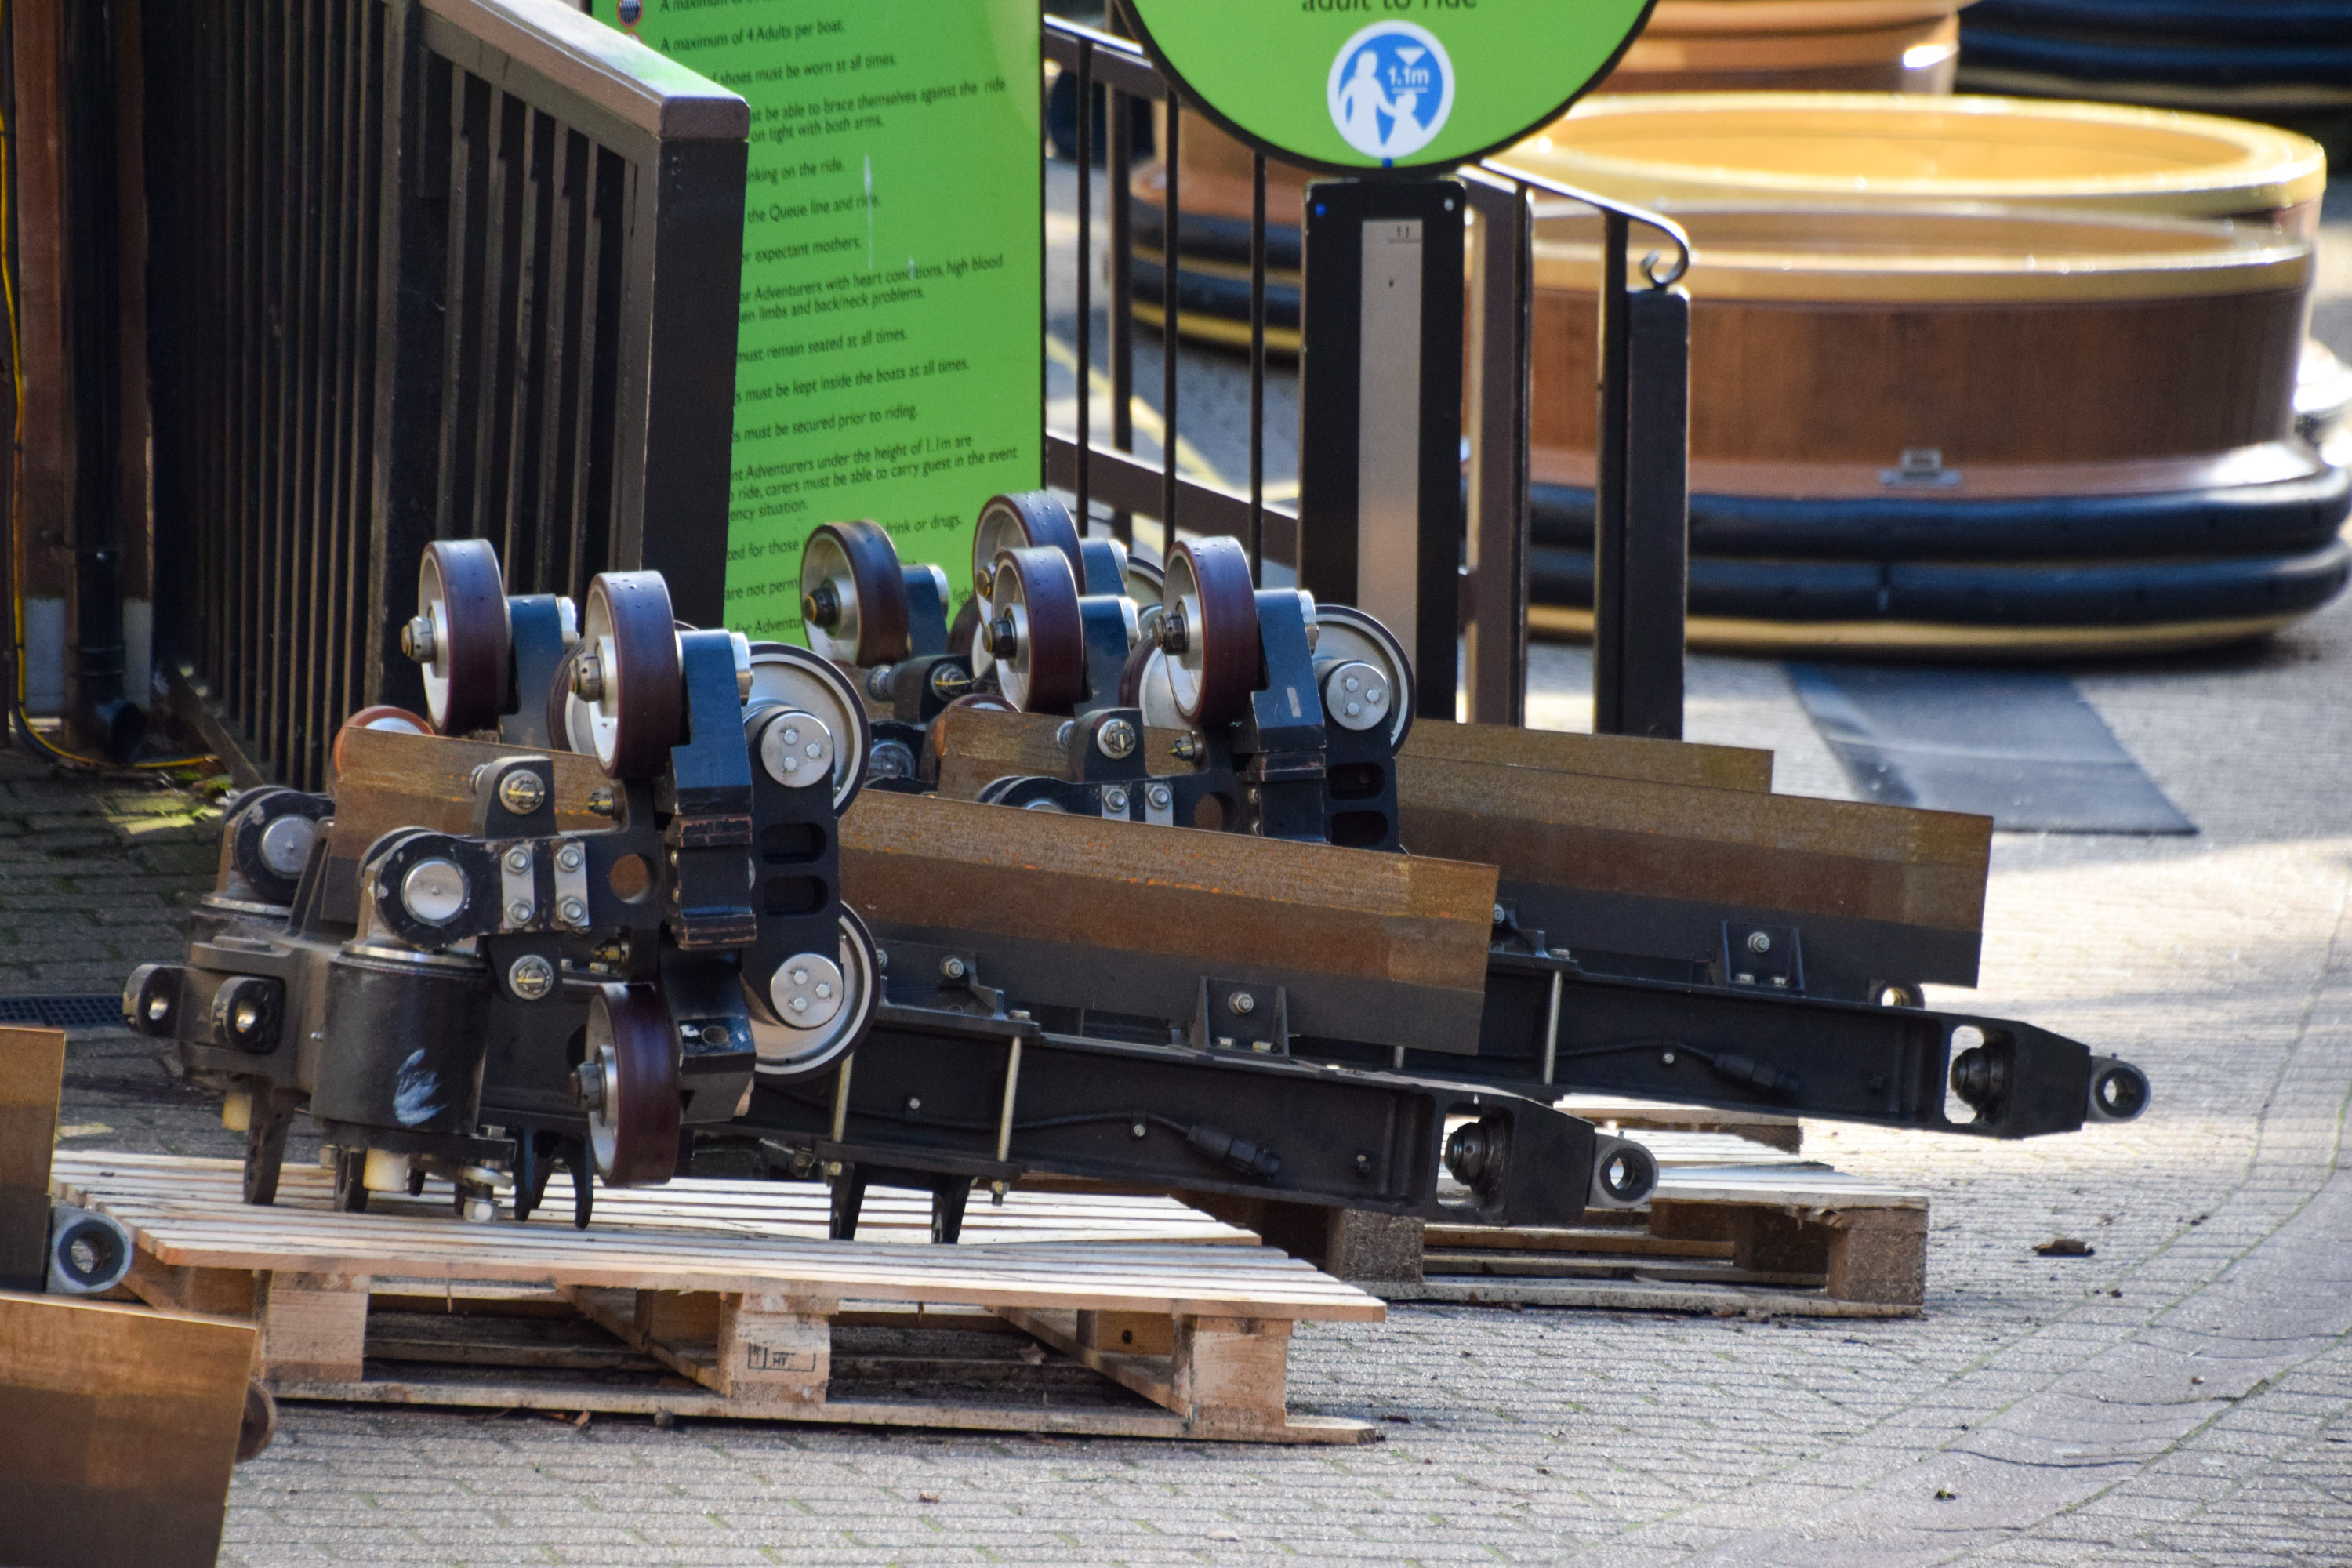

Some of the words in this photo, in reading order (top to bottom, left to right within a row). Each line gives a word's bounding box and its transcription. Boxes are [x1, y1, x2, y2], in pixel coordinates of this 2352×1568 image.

[660, 38, 670, 52] A
[673, 34, 728, 50] maximum
[731, 27, 743, 45] of
[747, 27, 753, 41] 4
[757, 22, 791, 41] Adults
[795, 24, 813, 40] per
[720, 71, 752, 85] shoes
[756, 67, 782, 82] must
[786, 64, 799, 78] be
[803, 61, 832, 75] worn
[836, 59, 846, 72] at
[849, 53, 862, 71] all
[1388, 67, 1429, 85] 1.1m
[765, 106, 779, 119] be
[783, 102, 804, 118] able
[808, 103, 820, 115] to
[824, 99, 853, 114] brace
[858, 89, 916, 110] themselves
[920, 85, 956, 107] against
[960, 80, 977, 97] the
[985, 76, 1006, 93] ride
[751, 130, 765, 143] on
[769, 125, 793, 144] tight
[798, 120, 821, 136] with
[826, 117, 850, 134] both
[781, 166, 795, 180] on
[799, 161, 816, 176] the
[747, 208, 765, 223] the
[769, 202, 808, 222] Queue
[811, 199, 829, 214] line
[833, 195, 853, 212] and
[755, 244, 808, 264] expectant
[755, 282, 822, 300] Adventurers
[826, 276, 850, 291] with
[853, 273, 881, 288] heart
[946, 260, 967, 278] high
[971, 251, 1003, 271] blood
[759, 306, 786, 320] limbs
[791, 299, 811, 316] and
[766, 344, 804, 359] remain
[808, 336, 843, 353] seated
[848, 335, 857, 348] at
[861, 329, 872, 346] all
[746, 387, 772, 401] must
[776, 383, 789, 397] be
[793, 380, 816, 397] kept
[821, 374, 851, 390] inside
[855, 371, 873, 386] the
[877, 367, 906, 383] boats
[909, 366, 920, 378] at
[924, 360, 935, 376] all
[746, 426, 771, 441] must
[775, 422, 789, 436] be
[793, 414, 835, 433] secured
[839, 413, 866, 431] prior
[870, 412, 882, 423] to
[746, 459, 813, 479] Adventurers
[818, 452, 850, 468] under
[854, 450, 871, 463] the
[875, 444, 907, 463] height
[910, 437, 922, 456] of
[927, 437, 951, 452] 1.1m
[955, 436, 972, 448] are
[765, 482, 800, 497] carers
[803, 476, 829, 490] must
[833, 472, 847, 486] be
[851, 469, 872, 484] able
[876, 470, 887, 480] to
[891, 463, 919, 478] carry
[923, 457, 951, 477] guest
[956, 456, 964, 467] in
[967, 451, 985, 466] the
[989, 448, 1017, 463] event
[748, 542, 765, 557] for
[768, 539, 799, 555] those
[914, 522, 926, 532] or
[746, 584, 765, 596] not
